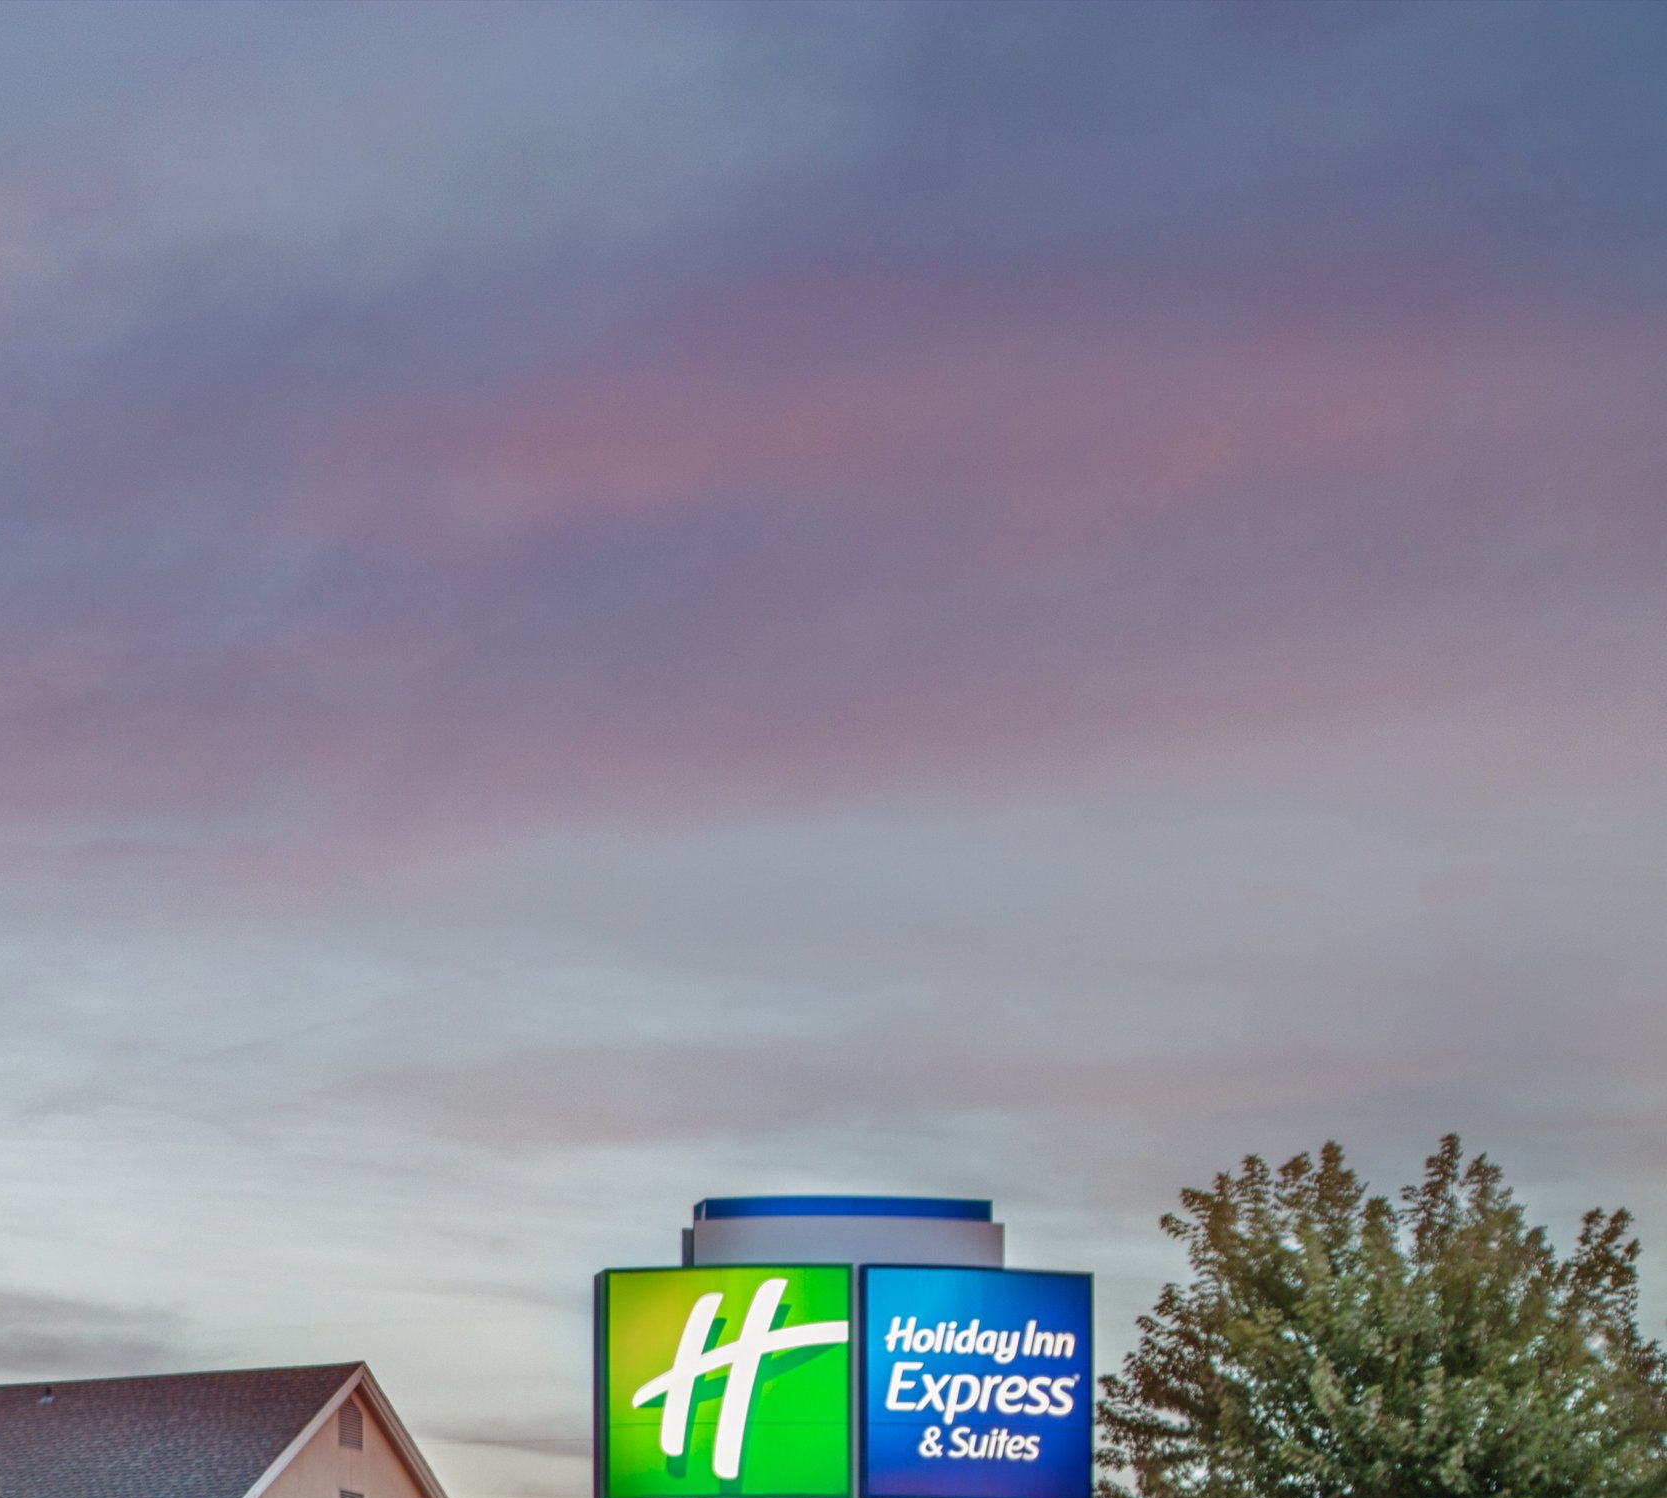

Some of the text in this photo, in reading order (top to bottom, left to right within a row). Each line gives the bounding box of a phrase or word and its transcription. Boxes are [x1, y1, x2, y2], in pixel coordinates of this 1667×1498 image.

[884, 1316, 1076, 1364] Holiday Inn
[885, 1361, 1077, 1426] Express
[917, 1425, 1041, 1461] & Suites
